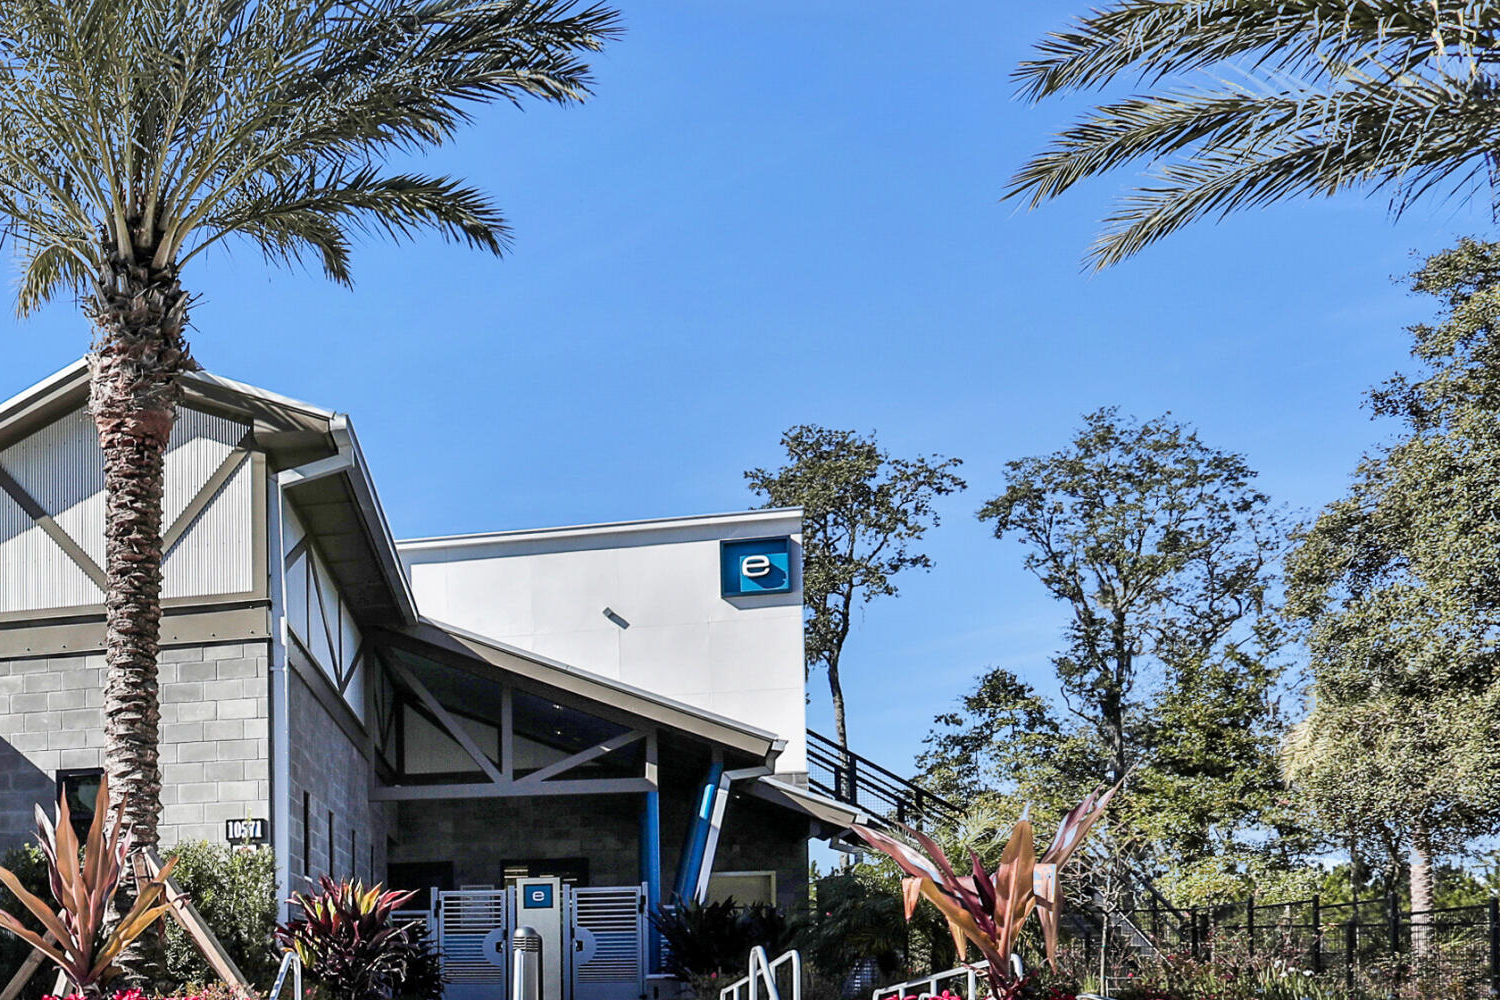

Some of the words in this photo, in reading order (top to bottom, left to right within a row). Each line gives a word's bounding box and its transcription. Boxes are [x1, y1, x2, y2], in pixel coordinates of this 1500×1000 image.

[742, 555, 770, 577] e
[228, 820, 262, 838] 10571
[532, 891, 545, 901] e
